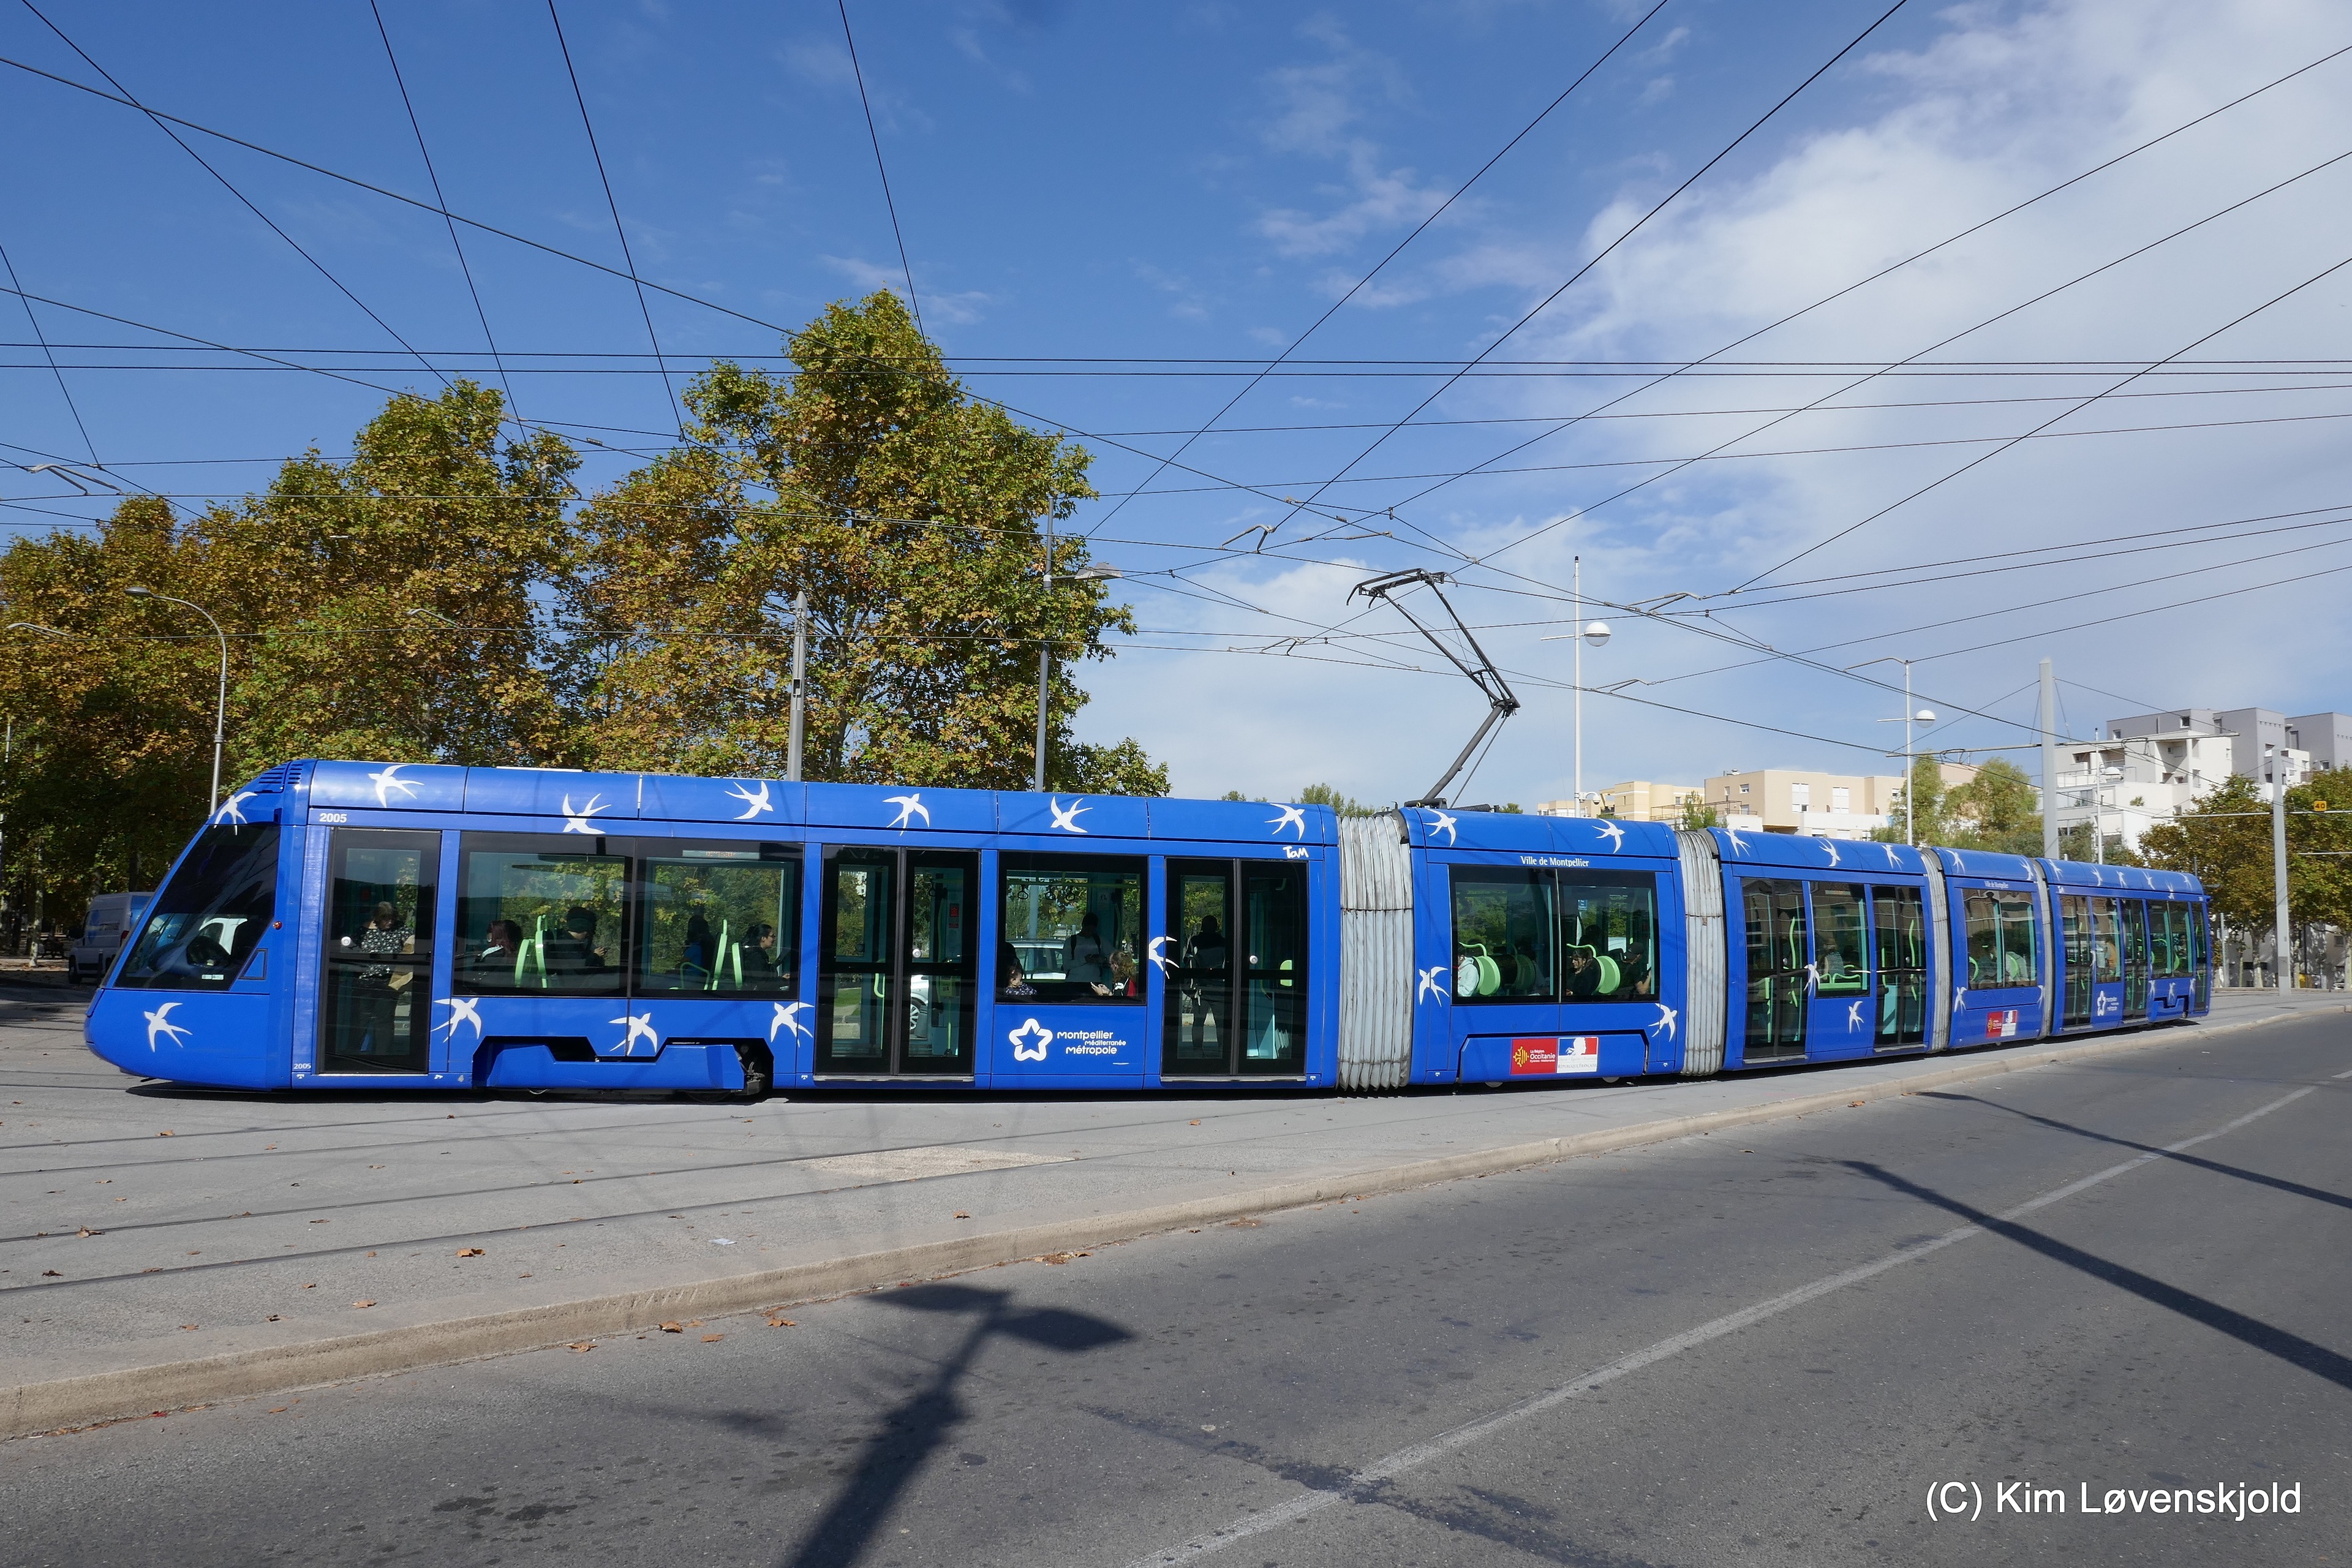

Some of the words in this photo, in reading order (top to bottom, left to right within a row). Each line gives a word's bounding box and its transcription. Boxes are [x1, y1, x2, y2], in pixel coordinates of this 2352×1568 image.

[319, 812, 347, 823] 2005
[1282, 846, 1309, 858] TaM
[1520, 856, 1537, 865] Ville
[1539, 856, 1548, 865] de
[1549, 857, 1589, 867] Montpellier
